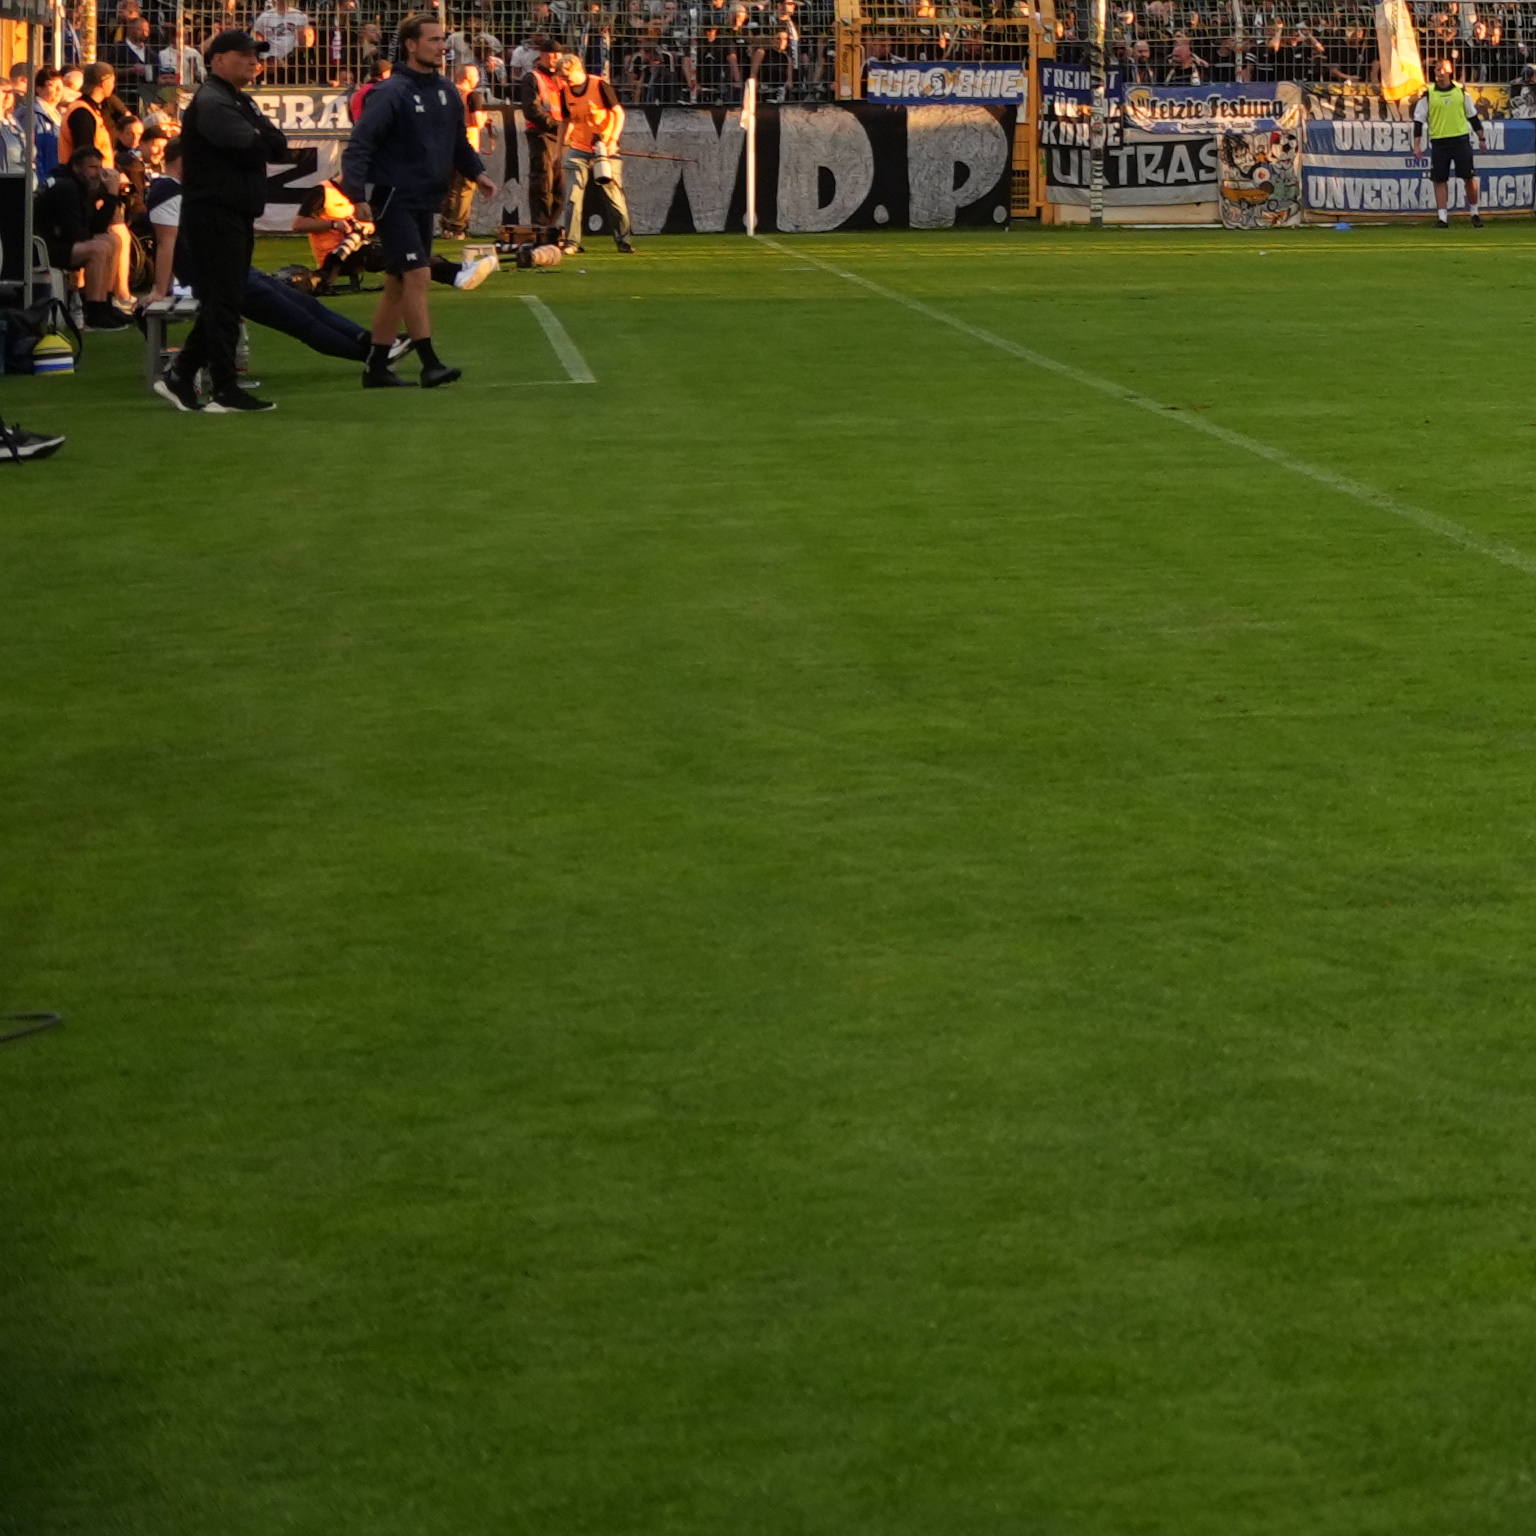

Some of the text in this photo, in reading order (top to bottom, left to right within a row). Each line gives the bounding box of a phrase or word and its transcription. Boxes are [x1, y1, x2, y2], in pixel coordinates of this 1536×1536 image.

[1042, 67, 1120, 91] FREIHIT
[1042, 90, 1079, 117] FÜR
[1041, 120, 1121, 148] KURE
